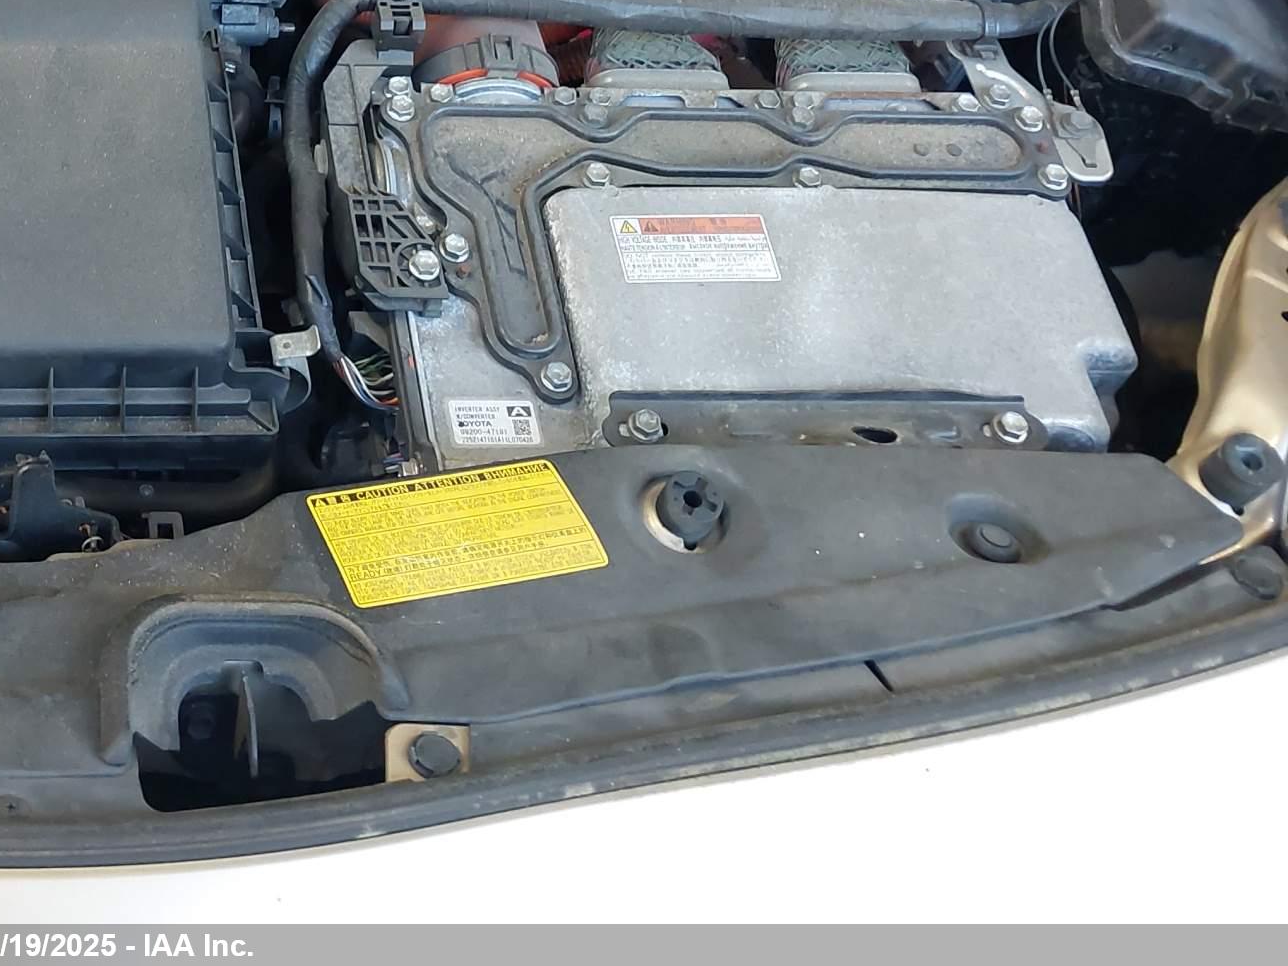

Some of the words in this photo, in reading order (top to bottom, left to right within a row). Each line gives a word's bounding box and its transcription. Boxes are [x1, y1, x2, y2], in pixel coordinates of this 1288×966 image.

[356, 484, 409, 500] CAUTION
[414, 474, 480, 491] ATTENTION
[485, 463, 549, 480] ВНИМАНИЕ
